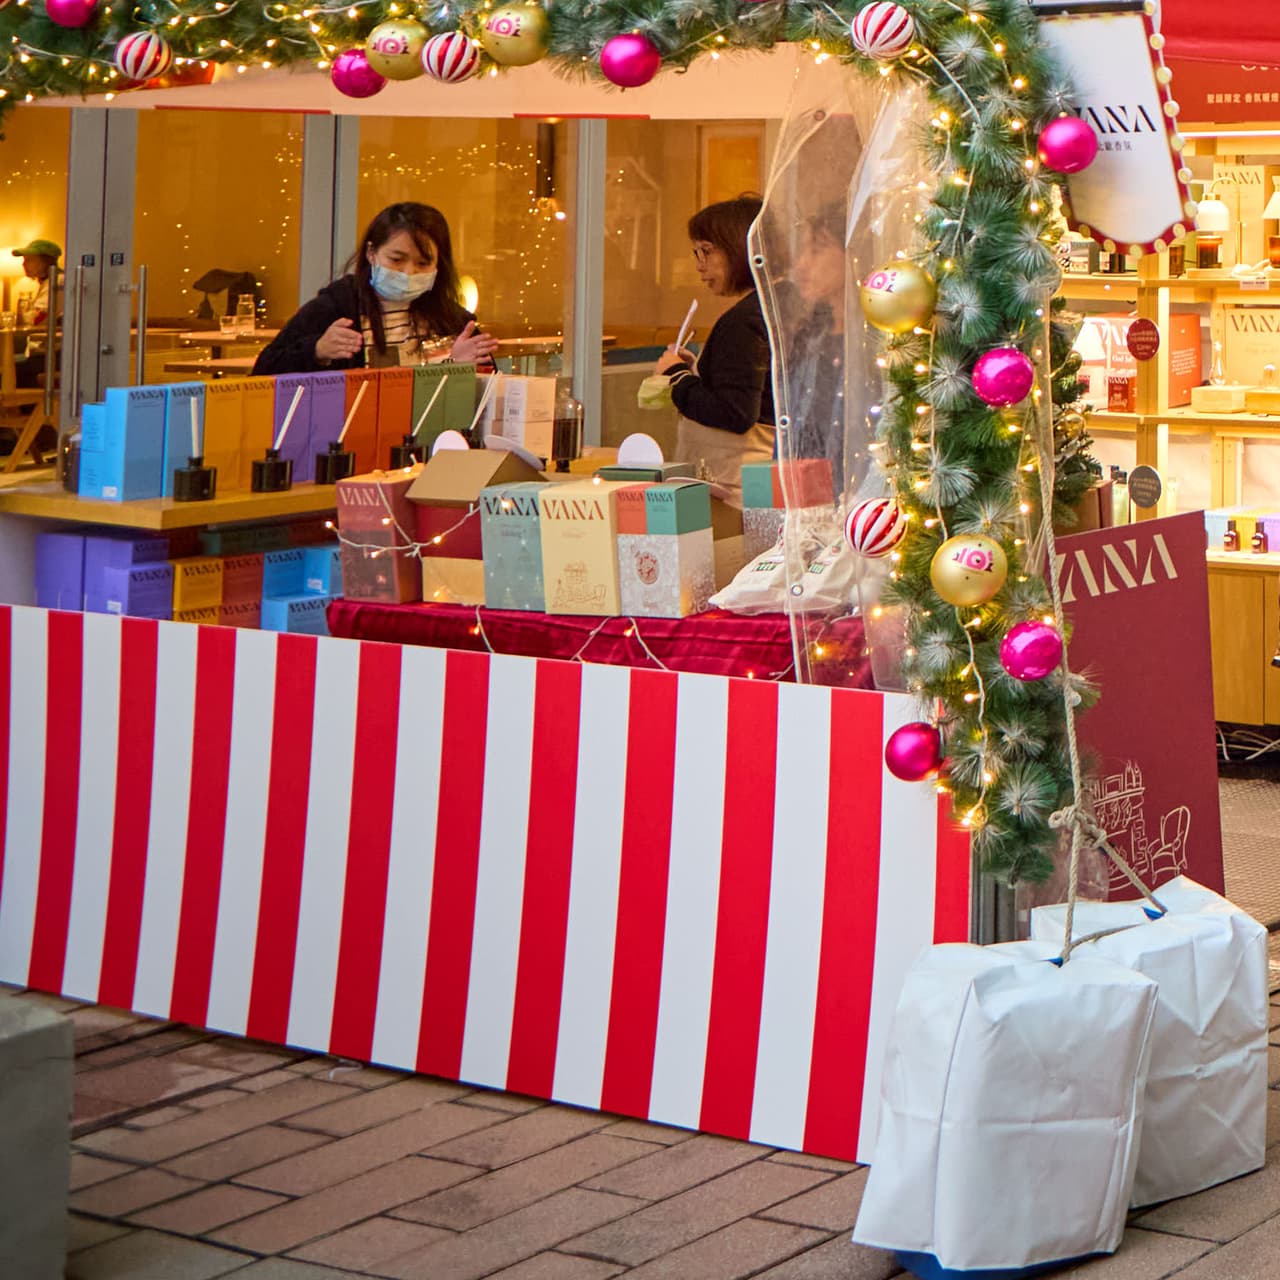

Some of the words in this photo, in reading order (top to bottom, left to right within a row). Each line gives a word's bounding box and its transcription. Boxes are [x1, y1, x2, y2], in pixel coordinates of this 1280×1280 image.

[339, 487, 386, 507] VANA
[483, 496, 540, 517] VANA
[542, 498, 605, 520] VANA
